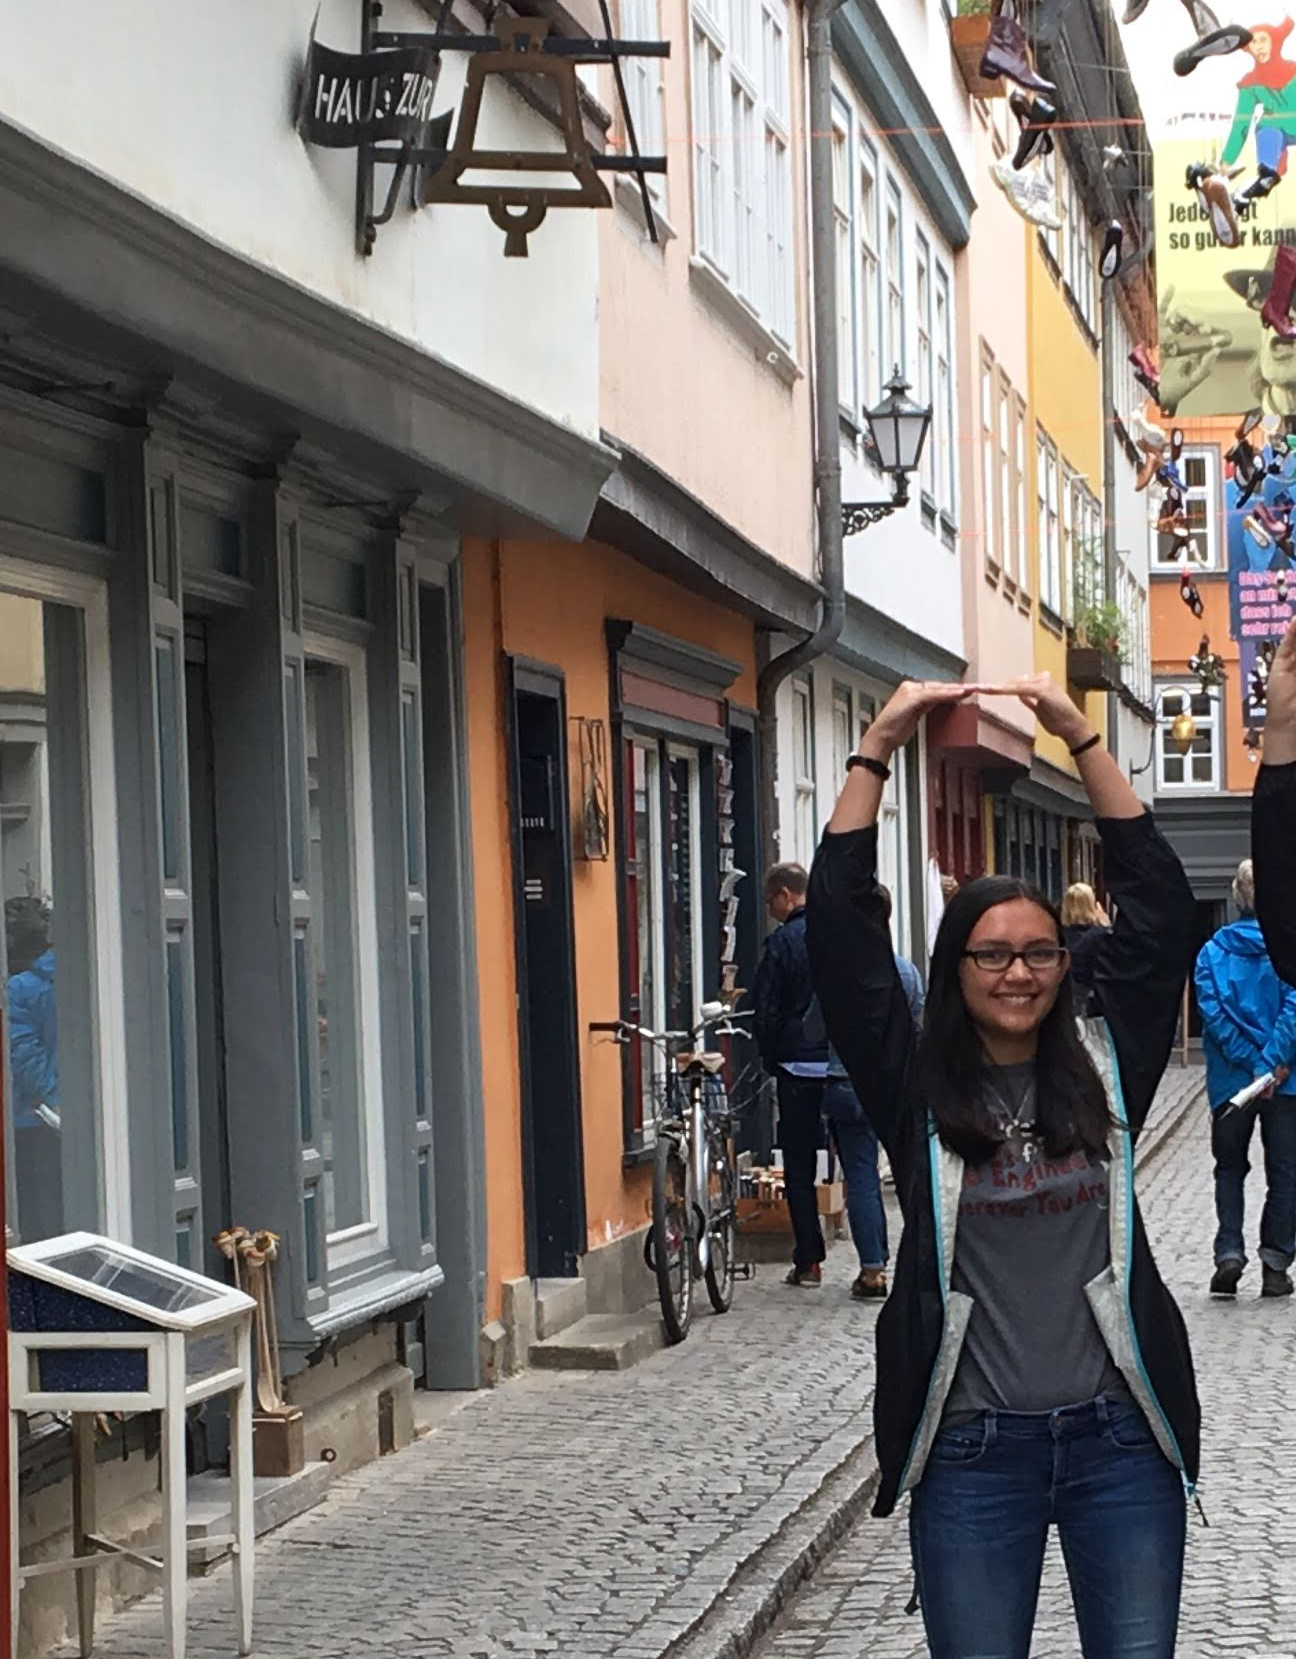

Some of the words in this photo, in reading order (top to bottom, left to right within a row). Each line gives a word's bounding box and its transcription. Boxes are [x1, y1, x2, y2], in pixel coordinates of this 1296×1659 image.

[315, 73, 394, 125] HAUS
[395, 72, 433, 123] ZUR
[1168, 202, 1210, 223] Jede
[1169, 229, 1190, 249] so
[1036, 1191, 1072, 1215] You
[1076, 1180, 1106, 1205] Are
